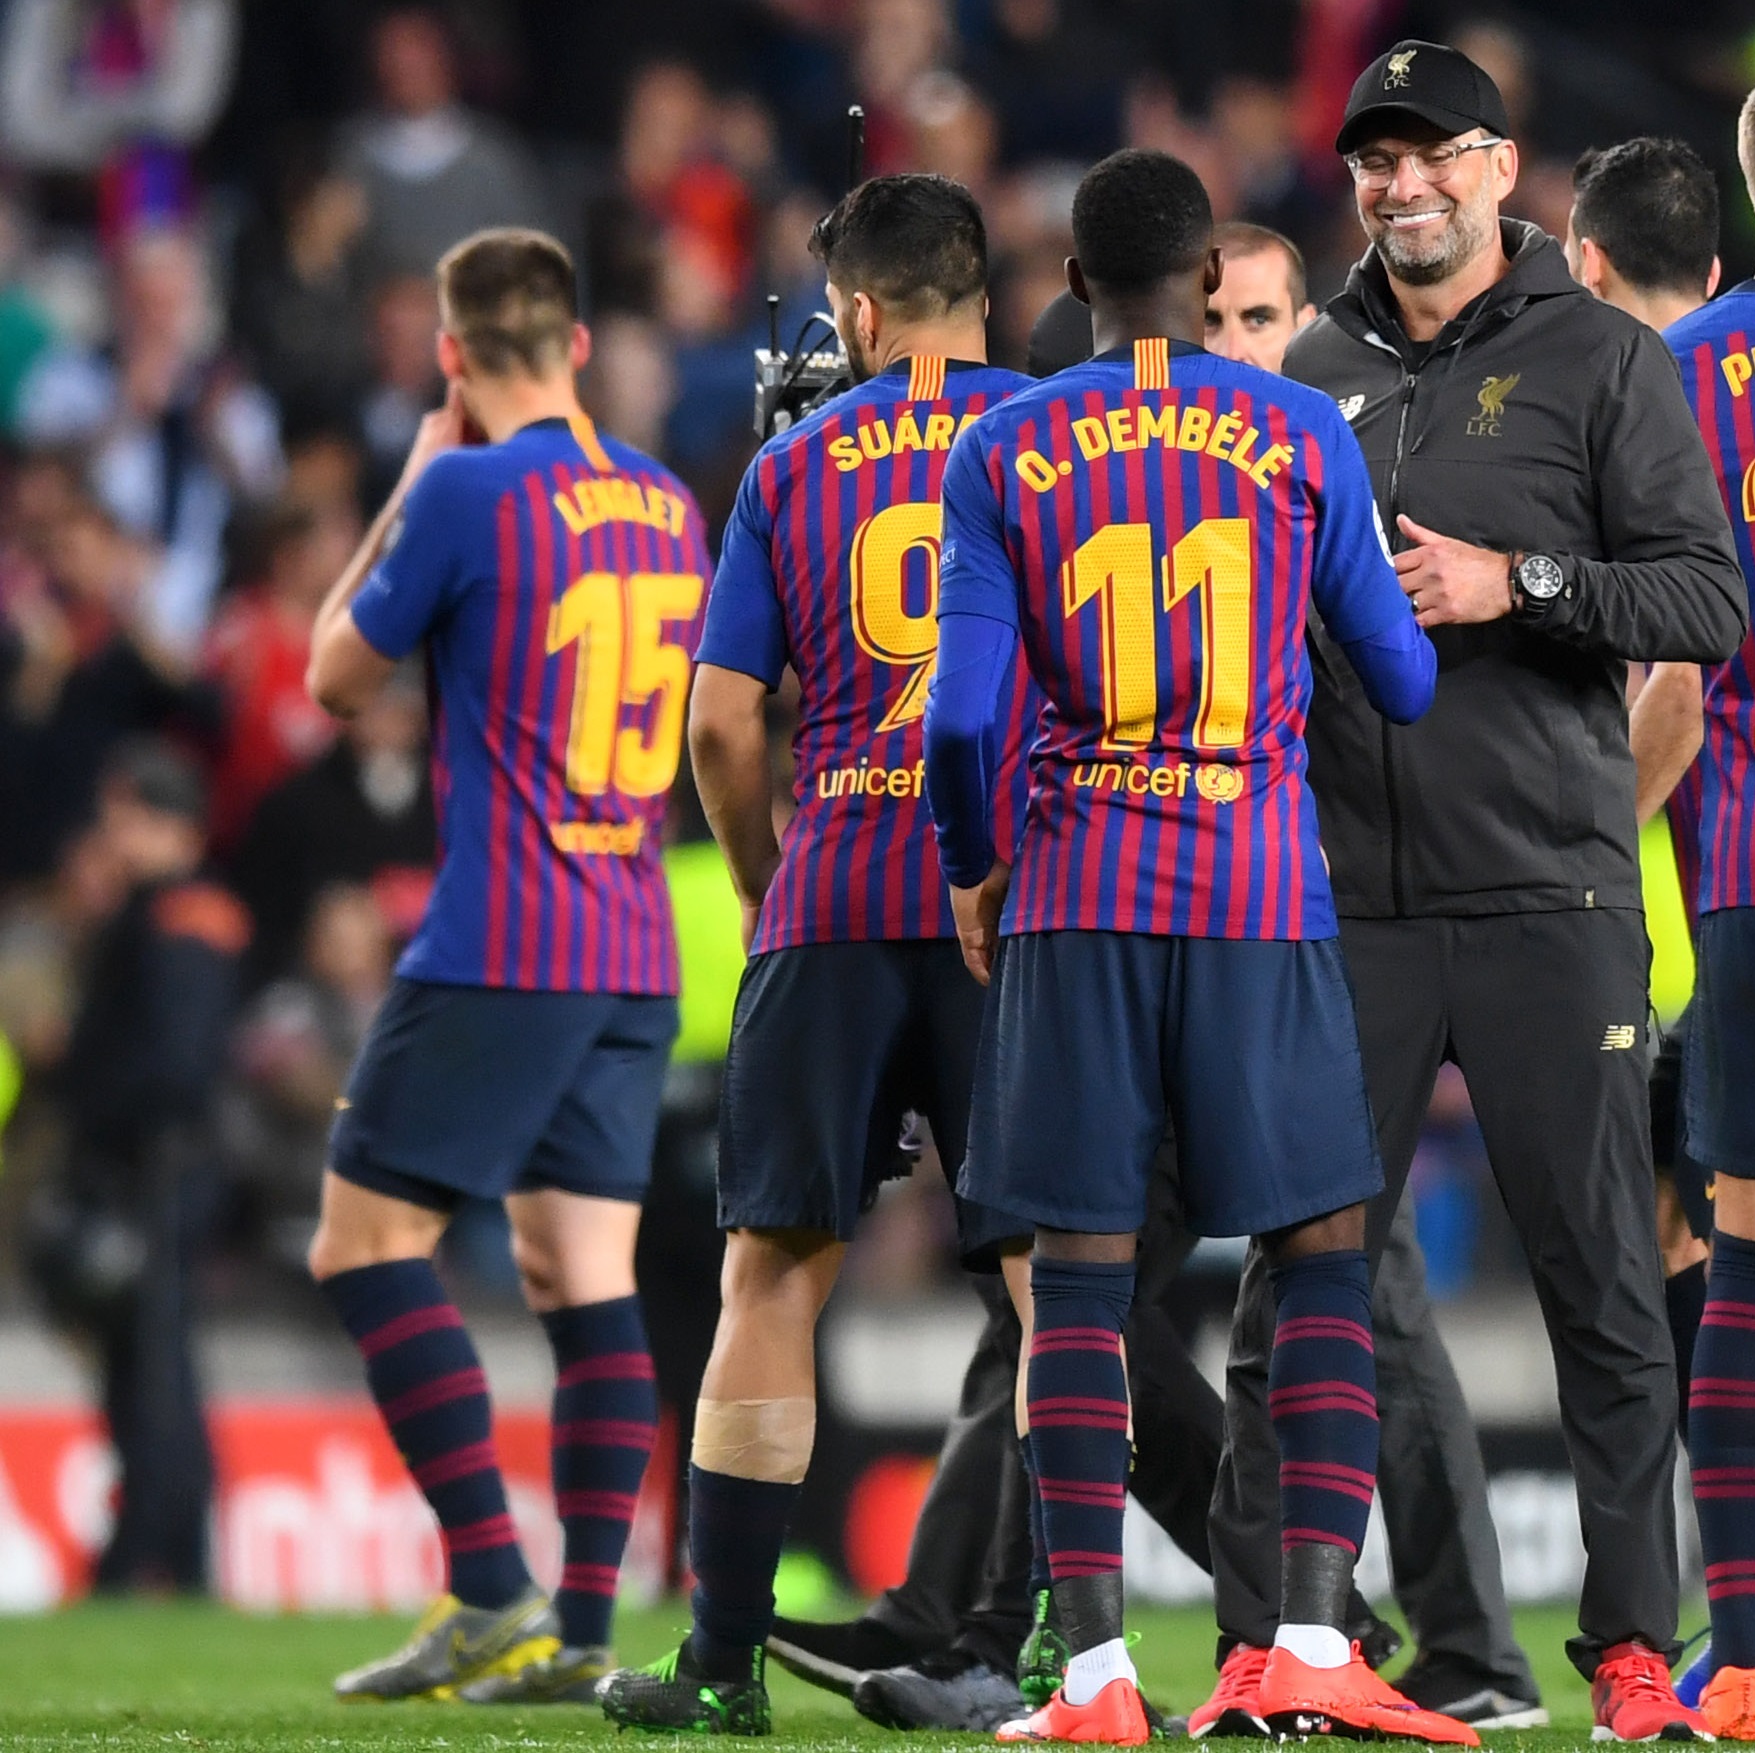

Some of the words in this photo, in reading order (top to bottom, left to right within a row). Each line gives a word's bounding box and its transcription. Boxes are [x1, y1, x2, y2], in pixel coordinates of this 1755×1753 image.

[1015, 450, 1073, 493] O.
[1071, 405, 1295, 490] DEMBÉLÉ
[554, 478, 687, 538] LENGLET
[849, 502, 941, 732] 9
[1063, 518, 1250, 751] 11
[546, 572, 705, 797] 15
[819, 757, 925, 799] unicef
[1073, 757, 1191, 799] unicef
[550, 816, 644, 856] unicef
